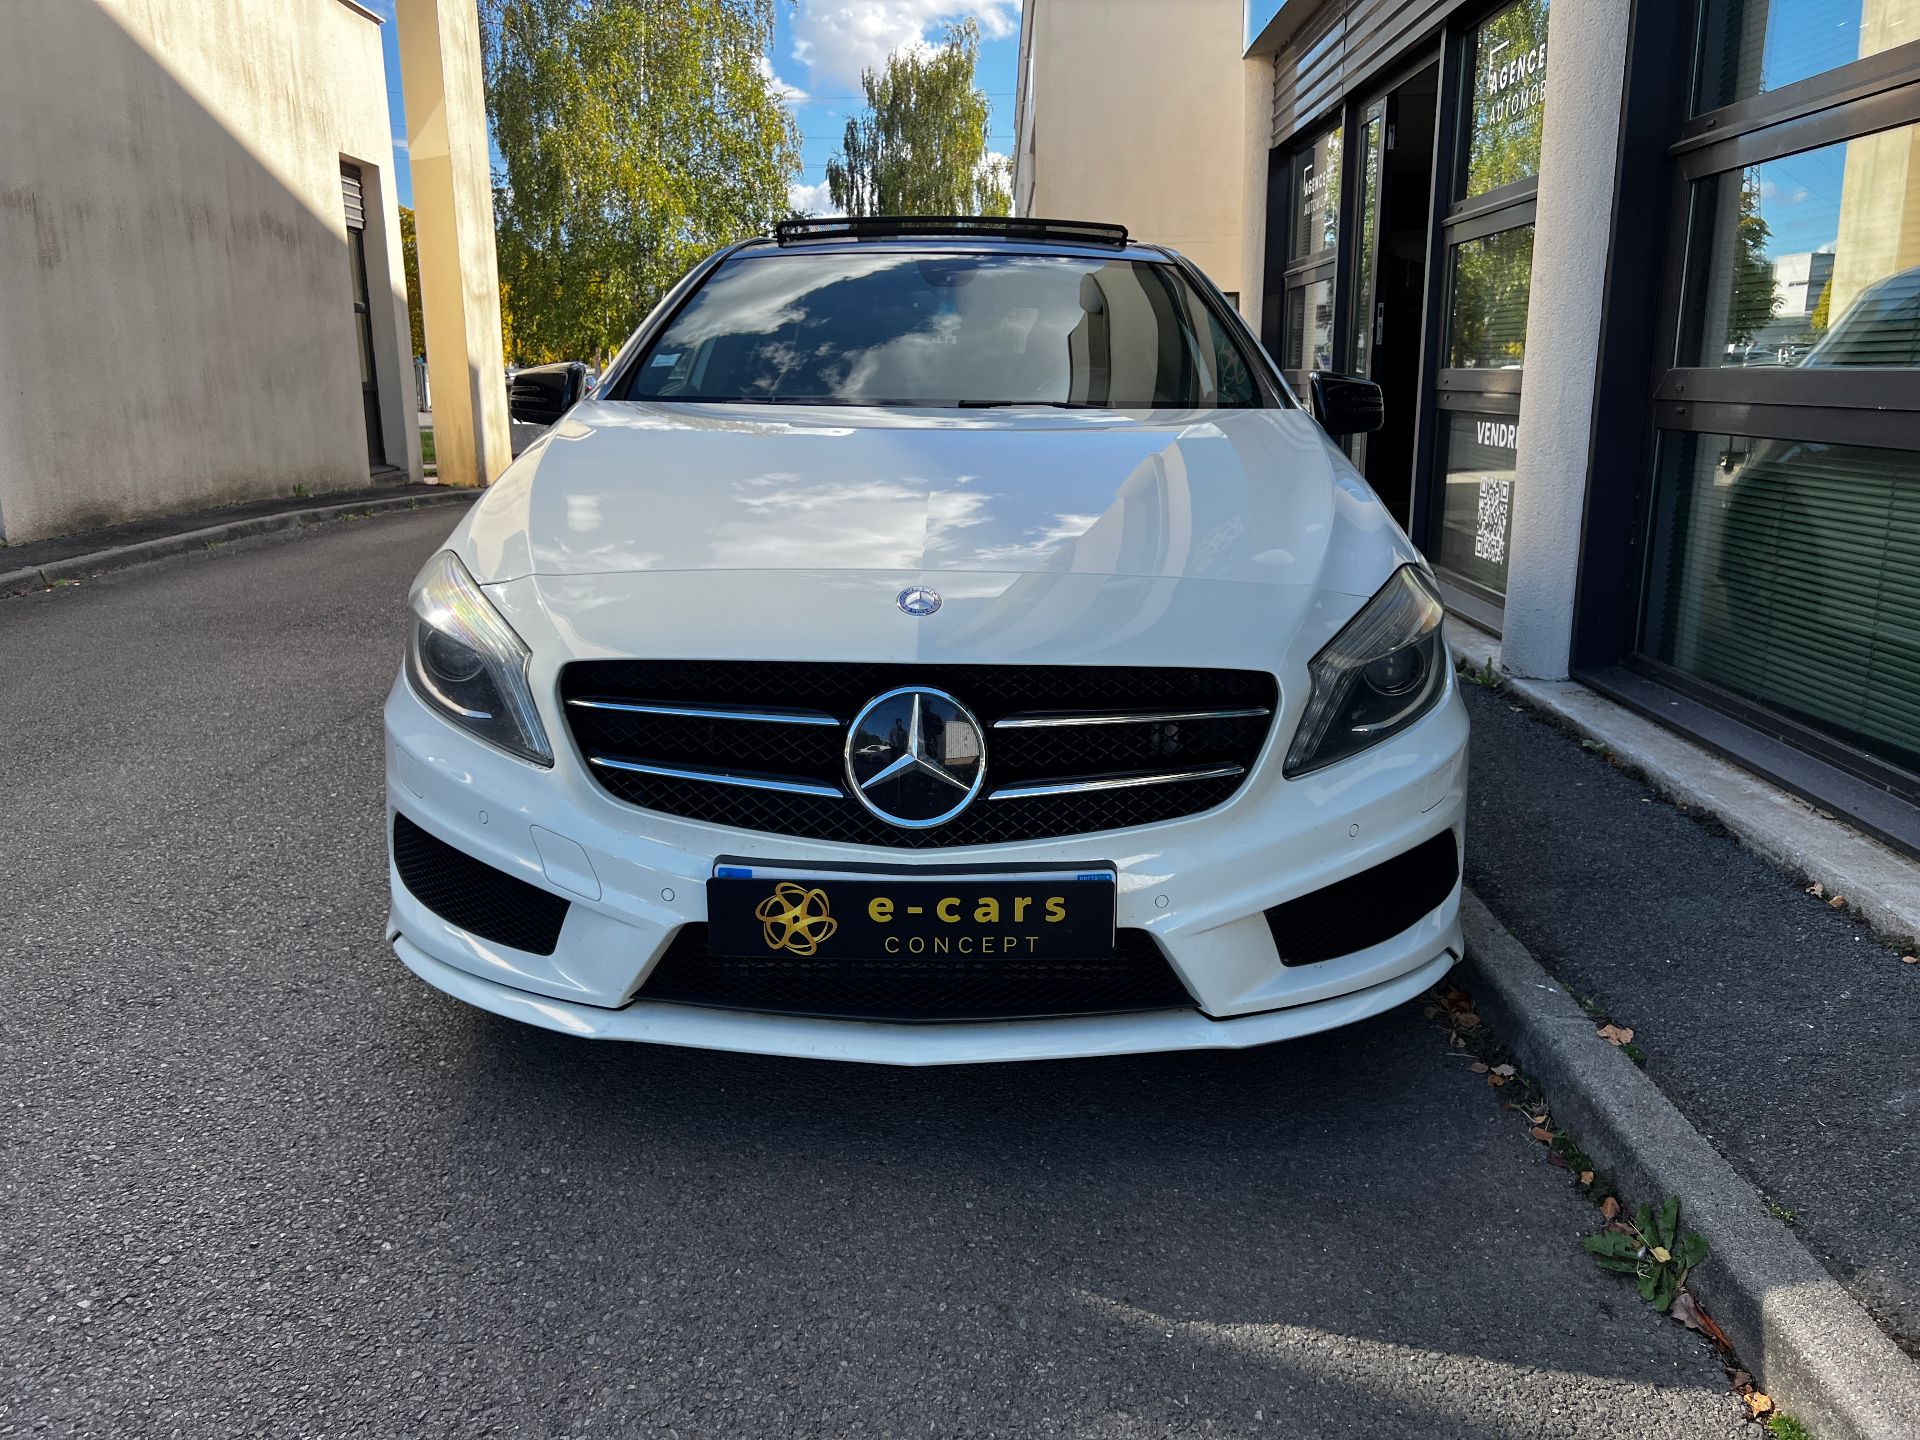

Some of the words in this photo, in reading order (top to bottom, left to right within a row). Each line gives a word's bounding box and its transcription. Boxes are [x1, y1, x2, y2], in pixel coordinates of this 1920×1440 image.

[1490, 43, 1547, 95] AGENCE
[868, 896, 1067, 923] e-cars
[885, 936, 1040, 954] CONCEPT
